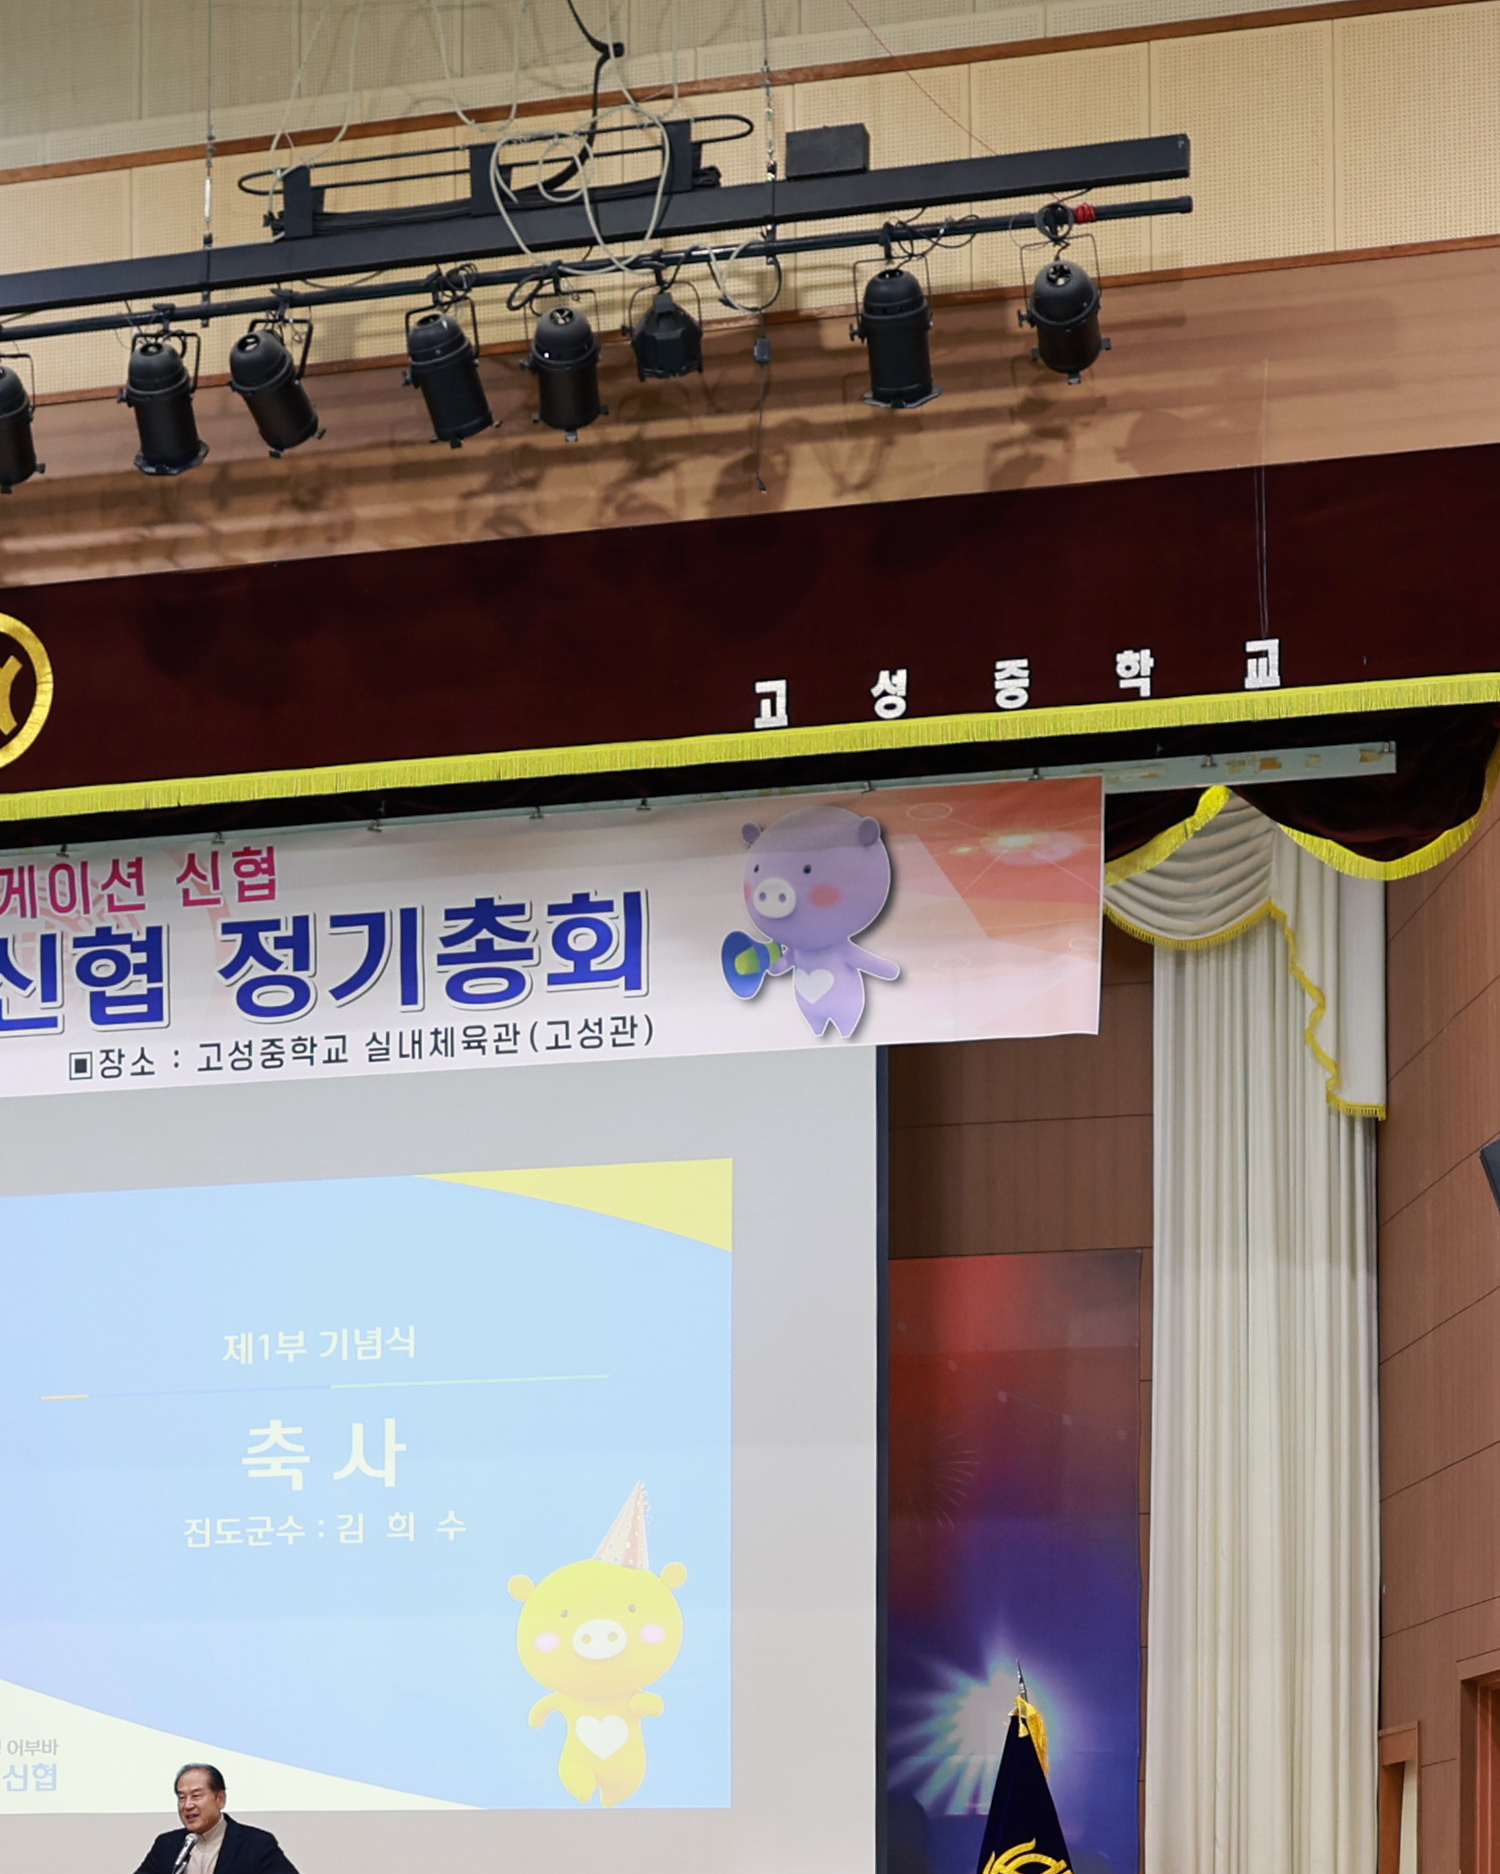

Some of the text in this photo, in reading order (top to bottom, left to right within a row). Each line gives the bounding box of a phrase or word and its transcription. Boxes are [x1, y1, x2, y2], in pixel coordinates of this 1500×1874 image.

[176, 845, 277, 907] 신협
[218, 891, 642, 1019] 정기총회
[99, 1047, 155, 1079] 장소
[197, 1035, 349, 1072] 고성중학교
[364, 1014, 655, 1063] 실내체육관(고성관)
[222, 1325, 415, 1365] 제1부 기념식
[184, 1515, 306, 1548] 진도군수
[7, 1738, 59, 1756] 어부바
[2, 1763, 58, 1792] 신협
